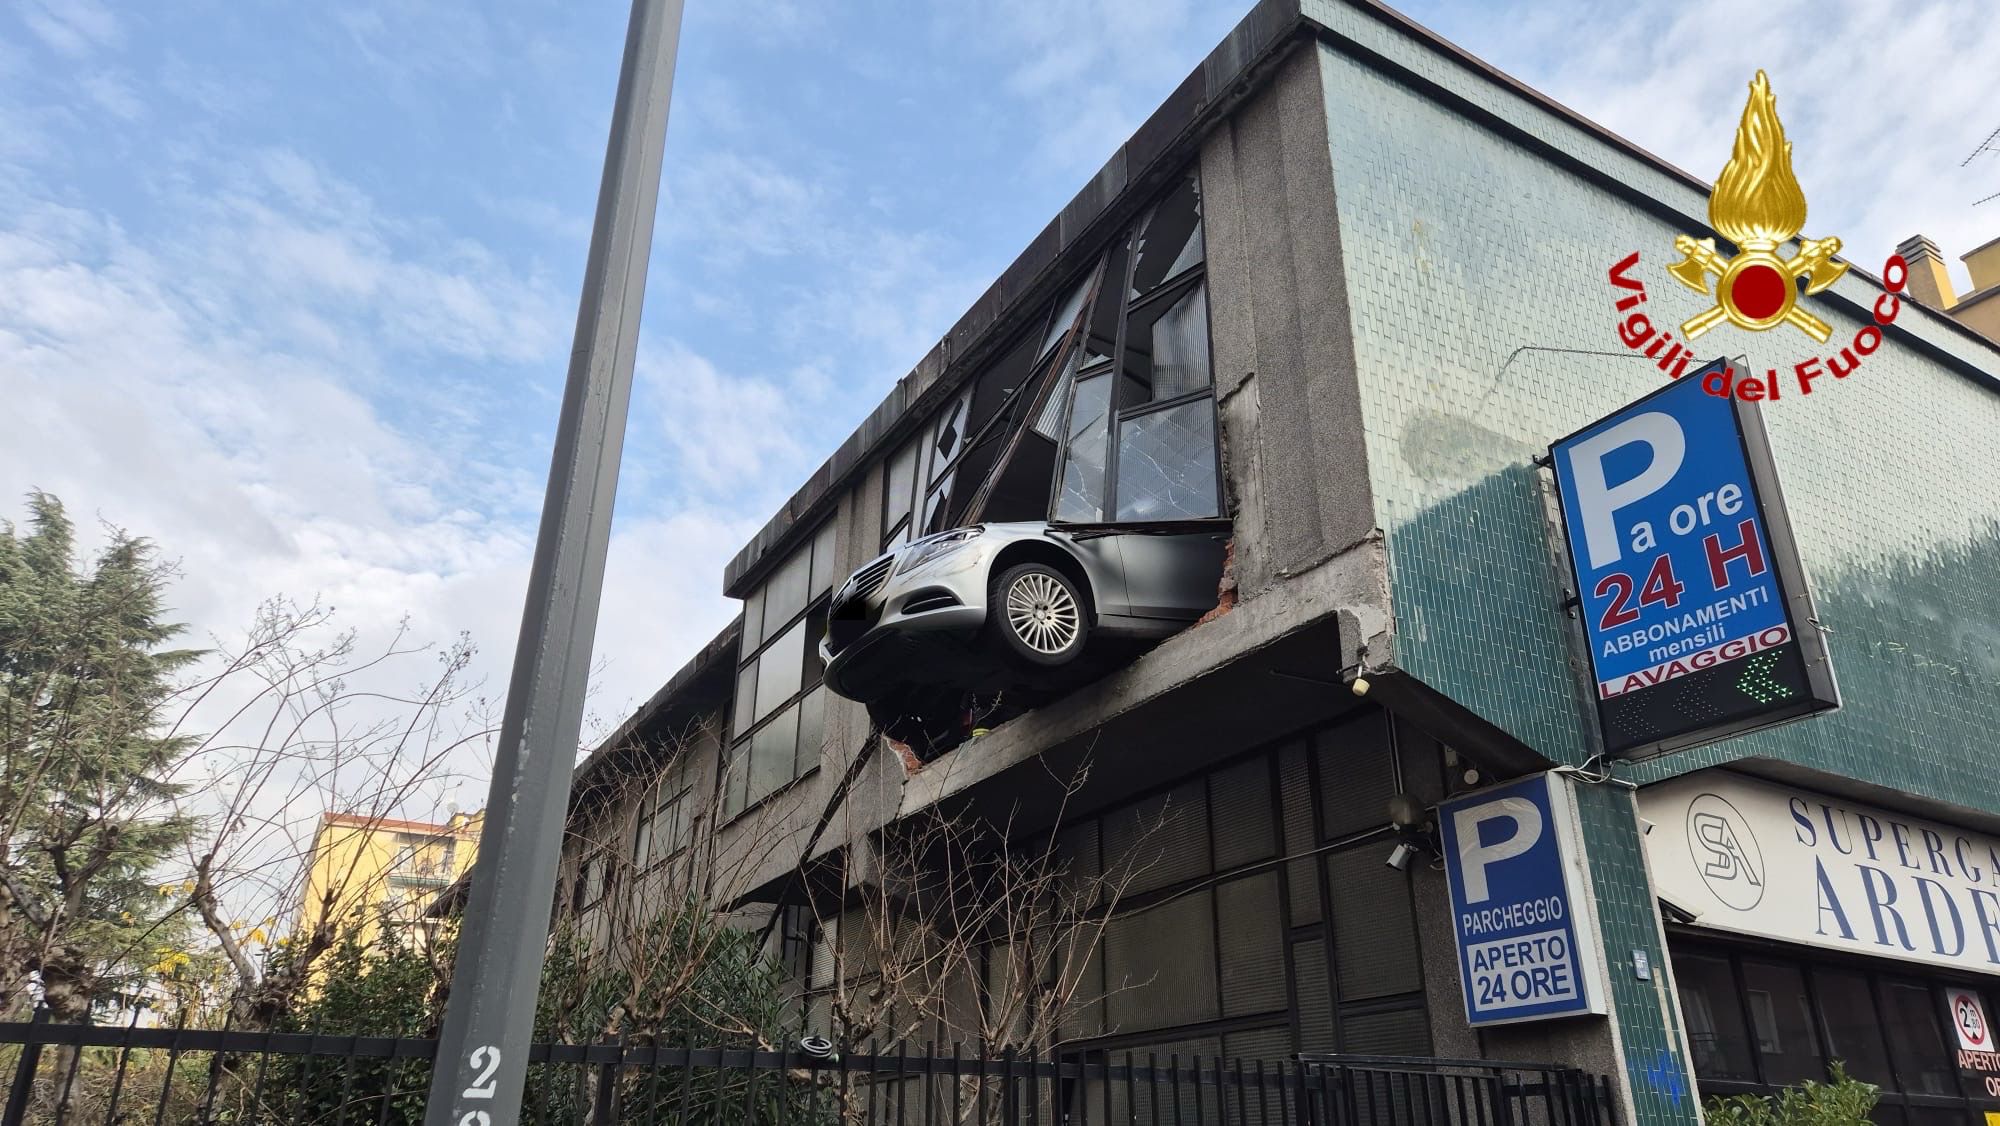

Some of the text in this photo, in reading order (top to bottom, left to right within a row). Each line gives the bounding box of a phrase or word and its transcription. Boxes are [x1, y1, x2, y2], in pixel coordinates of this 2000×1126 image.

[1568, 411, 1743, 570] P a ore
[1594, 518, 1768, 633] 24 H
[1603, 585, 1769, 658] ABBONAMENTI
[1648, 624, 1727, 663] mensili
[1601, 626, 1788, 700] LAVAGGIO
[1453, 796, 1543, 904] P
[1462, 895, 1563, 936] PARCHEGGIO
[1815, 854, 2000, 964] ARDE
[1473, 935, 1566, 972] APERTO
[1477, 964, 1571, 1005] 24 ORE
